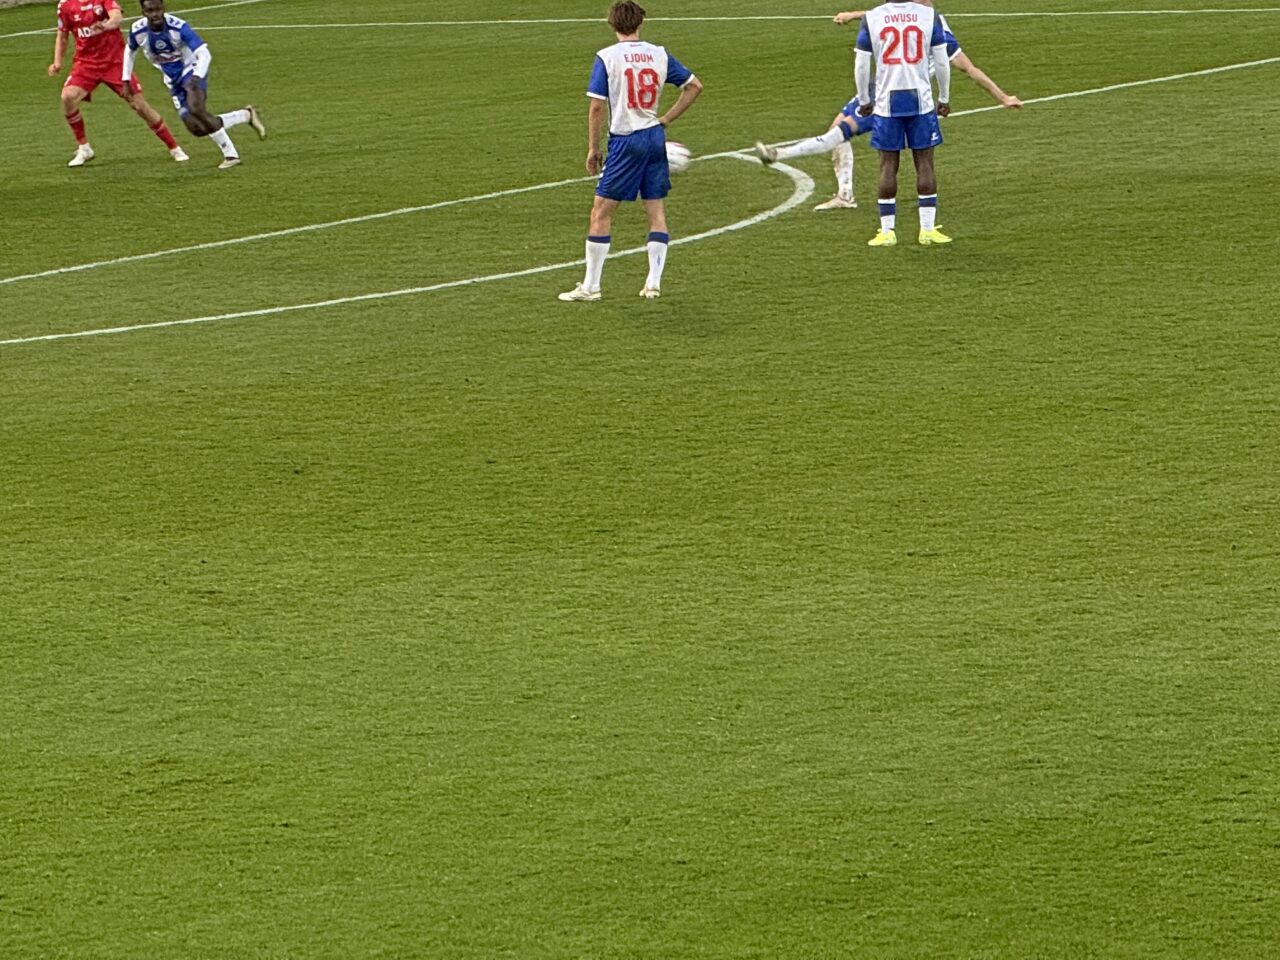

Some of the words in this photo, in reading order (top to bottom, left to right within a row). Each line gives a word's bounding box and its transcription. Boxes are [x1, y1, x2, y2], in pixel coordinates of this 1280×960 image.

[884, 13, 918, 24] OWUSU
[879, 25, 924, 65] 20
[623, 67, 660, 110] 18
